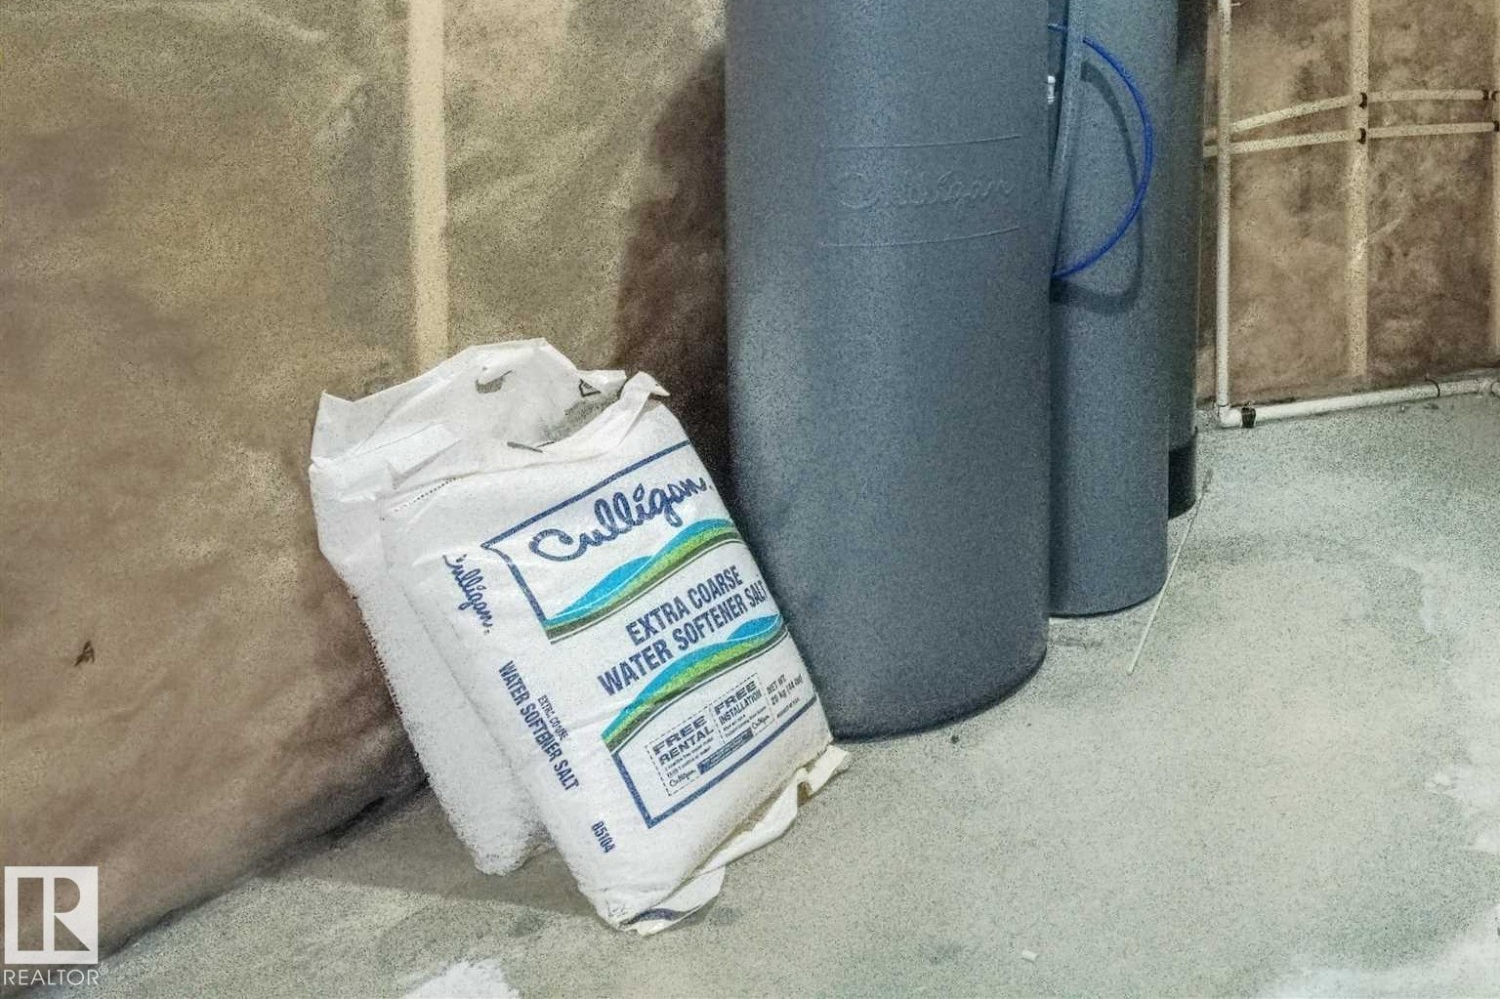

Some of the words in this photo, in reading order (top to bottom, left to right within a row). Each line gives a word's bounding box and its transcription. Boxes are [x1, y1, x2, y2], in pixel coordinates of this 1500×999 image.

[624, 588, 691, 647] EXTRA
[687, 564, 744, 613] COARSE
[596, 642, 675, 697] WATER
[672, 596, 752, 652] SOFTENER
[742, 579, 769, 609] SALT
[714, 681, 757, 716] FREE
[718, 688, 763, 726] INSTALLATION
[499, 660, 530, 707] WATER
[519, 700, 557, 764] SOFTENER
[553, 752, 581, 792] SALT
[653, 715, 707, 756] FREE
[658, 726, 714, 766] RENTAL
[591, 821, 616, 853] 85104
